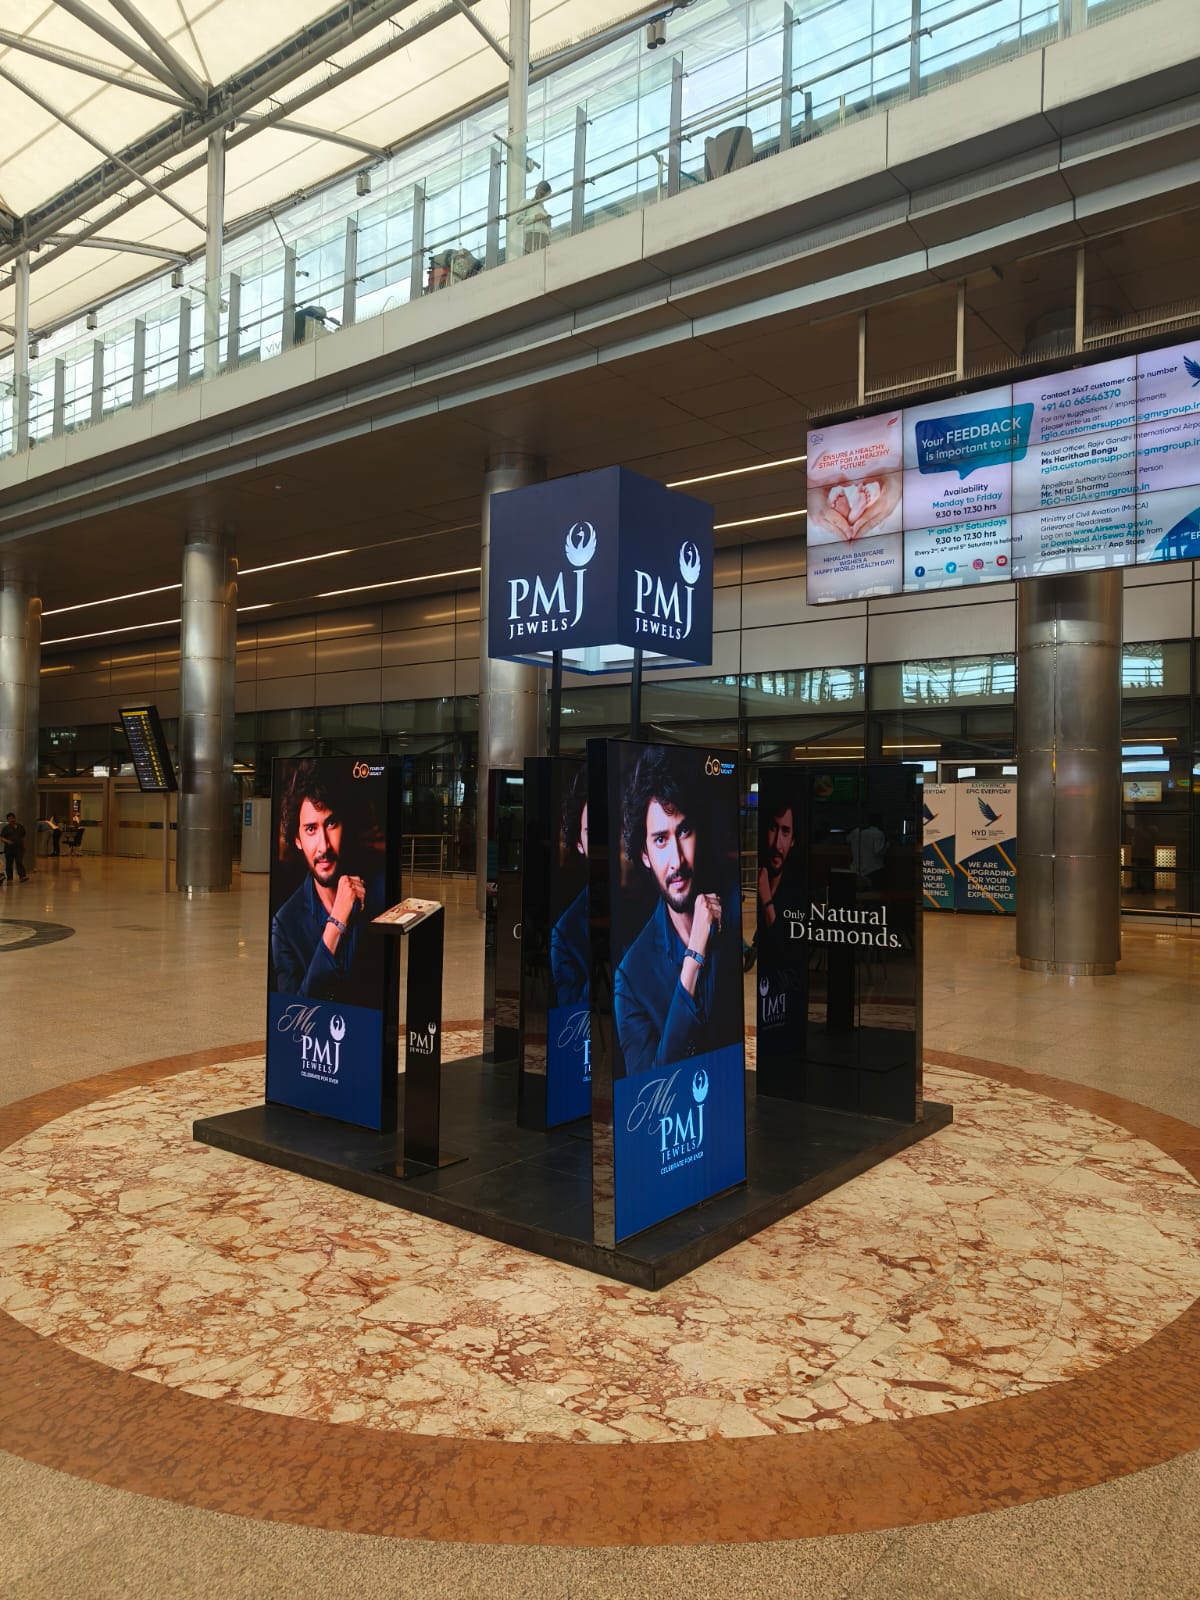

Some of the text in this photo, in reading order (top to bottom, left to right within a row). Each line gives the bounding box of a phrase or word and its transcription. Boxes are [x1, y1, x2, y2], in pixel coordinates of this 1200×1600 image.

[1041, 390, 1070, 401] Contact
[1072, 385, 1088, 395] 24x7
[1090, 378, 1125, 390] customer
[1147, 366, 1178, 378] number
[1041, 388, 1121, 412] +91 40 66546370
[1067, 406, 1107, 418] suggestions
[922, 416, 1021, 449] Your FEEDBACK
[1041, 423, 1064, 434] please
[1065, 419, 1081, 427] write
[1041, 448, 1061, 457] Nodal
[1088, 440, 1105, 449] Rajiv
[1106, 434, 1132, 444] Gandhi
[1134, 423, 1182, 439] International
[818, 460, 838, 469] START
[860, 449, 890, 460] HEALTHY
[823, 450, 848, 462] ENSURE
[855, 444, 885, 454] HEALTHY
[926, 452, 934, 461] is
[936, 443, 987, 459] important
[990, 440, 1001, 448] to
[1054, 451, 1090, 463] Harithaa
[1091, 446, 1118, 456] Bongu
[1041, 480, 1074, 490] Appellate
[1074, 473, 1106, 484] Authority
[1139, 464, 1164, 473] Person
[944, 483, 989, 497] Availability
[1041, 482, 1109, 499] Mr. Mitul Sharma
[933, 498, 965, 509] Monday
[977, 492, 1003, 503] Friday
[935, 510, 952, 519] 9.30
[953, 508, 962, 516] to
[984, 503, 997, 511] hrs
[1041, 515, 1066, 524] Ministry
[1075, 510, 1090, 518] Civil
[1091, 506, 1120, 516] Aviation
[937, 526, 953, 535] and
[965, 518, 1007, 530] Saturdays
[1041, 521, 1074, 531] Grievance
[935, 536, 952, 545] 9.30
[953, 535, 962, 543] to
[984, 530, 997, 538] hrs
[967, 540, 993, 549] Saturday
[1050, 536, 1090, 548] Download
[1091, 532, 1125, 541] AirSewa
[1127, 529, 1144, 538] App
[1147, 527, 1163, 535] from
[853, 548, 884, 559] BABYCARE
[1067, 546, 1082, 554] Play
[814, 559, 895, 576] HAPPY WORLD HEALTH DAY!
[840, 558, 862, 566] WISHES
[507, 568, 587, 627] PMJ
[634, 569, 695, 639] PMJ
[509, 617, 568, 640] JEWELS
[635, 617, 682, 640] JEWELS
[352, 761, 369, 779] 60
[705, 754, 721, 776] 60
[967, 869, 1016, 877] UPGRADING
[982, 861, 999, 869] ARE
[967, 883, 1011, 892] ENHANCED
[967, 891, 1015, 900] EXPERIENCE
[783, 902, 888, 926] Only Natural
[790, 921, 902, 948] Diamonds.
[278, 1004, 322, 1043] My
[410, 1031, 434, 1054] PMJ
[301, 1034, 342, 1075] PMJ
[302, 1060, 332, 1074] JEWELS
[627, 1068, 682, 1135] My
[659, 1104, 705, 1152] PMJ
[662, 1140, 696, 1164] JEWELS
